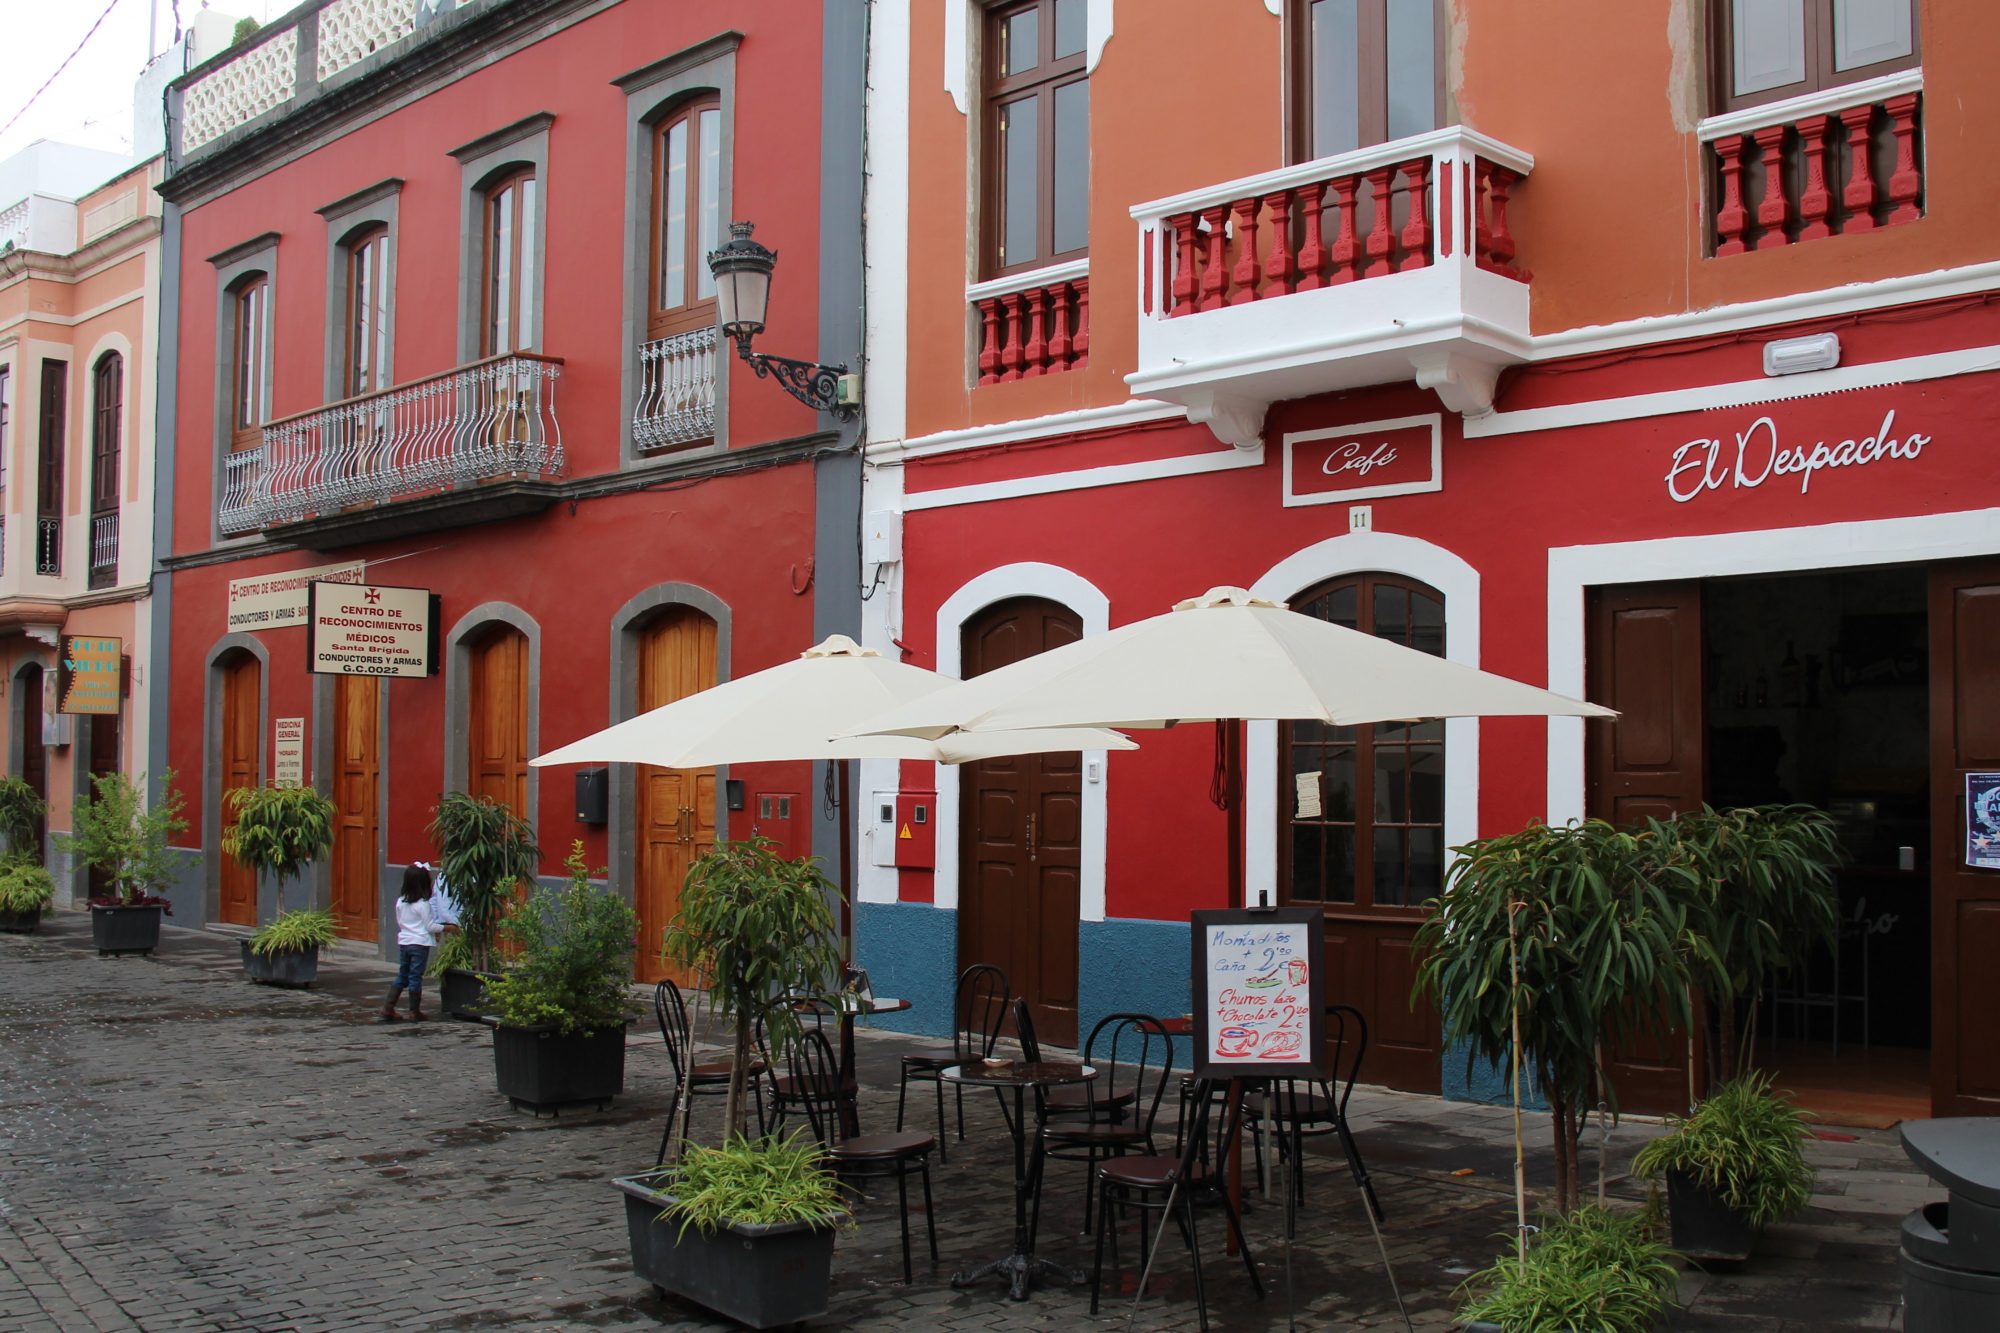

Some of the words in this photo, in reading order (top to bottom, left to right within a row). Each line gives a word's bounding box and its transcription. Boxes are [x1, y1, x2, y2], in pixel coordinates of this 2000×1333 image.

[1321, 441, 1398, 476] Café
[1664, 437, 1729, 503] El
[1733, 409, 1932, 494] Despacho
[1353, 511, 1366, 528] 11
[240, 583, 260, 597] CENTRO
[261, 582, 269, 594] DE
[229, 610, 269, 626] CONDUCTORES
[270, 609, 275, 620] Y
[275, 607, 295, 620] ARMAS
[341, 605, 384, 617] CENTRO
[388, 608, 403, 618] DE
[319, 616, 423, 632] RECONOCIMIENTOS
[346, 632, 396, 644] MÉDICOS
[331, 643, 365, 652] Santa
[318, 653, 383, 665] CONDUCTORES
[385, 657, 392, 665] Y
[393, 657, 423, 666] ARMAS
[342, 664, 399, 674] G.C.0022
[277, 721, 301, 729] MEDICINA
[278, 730, 300, 738] GENERAL
[1214, 959, 1247, 972] Caña
[1218, 988, 1268, 1006] Churros
